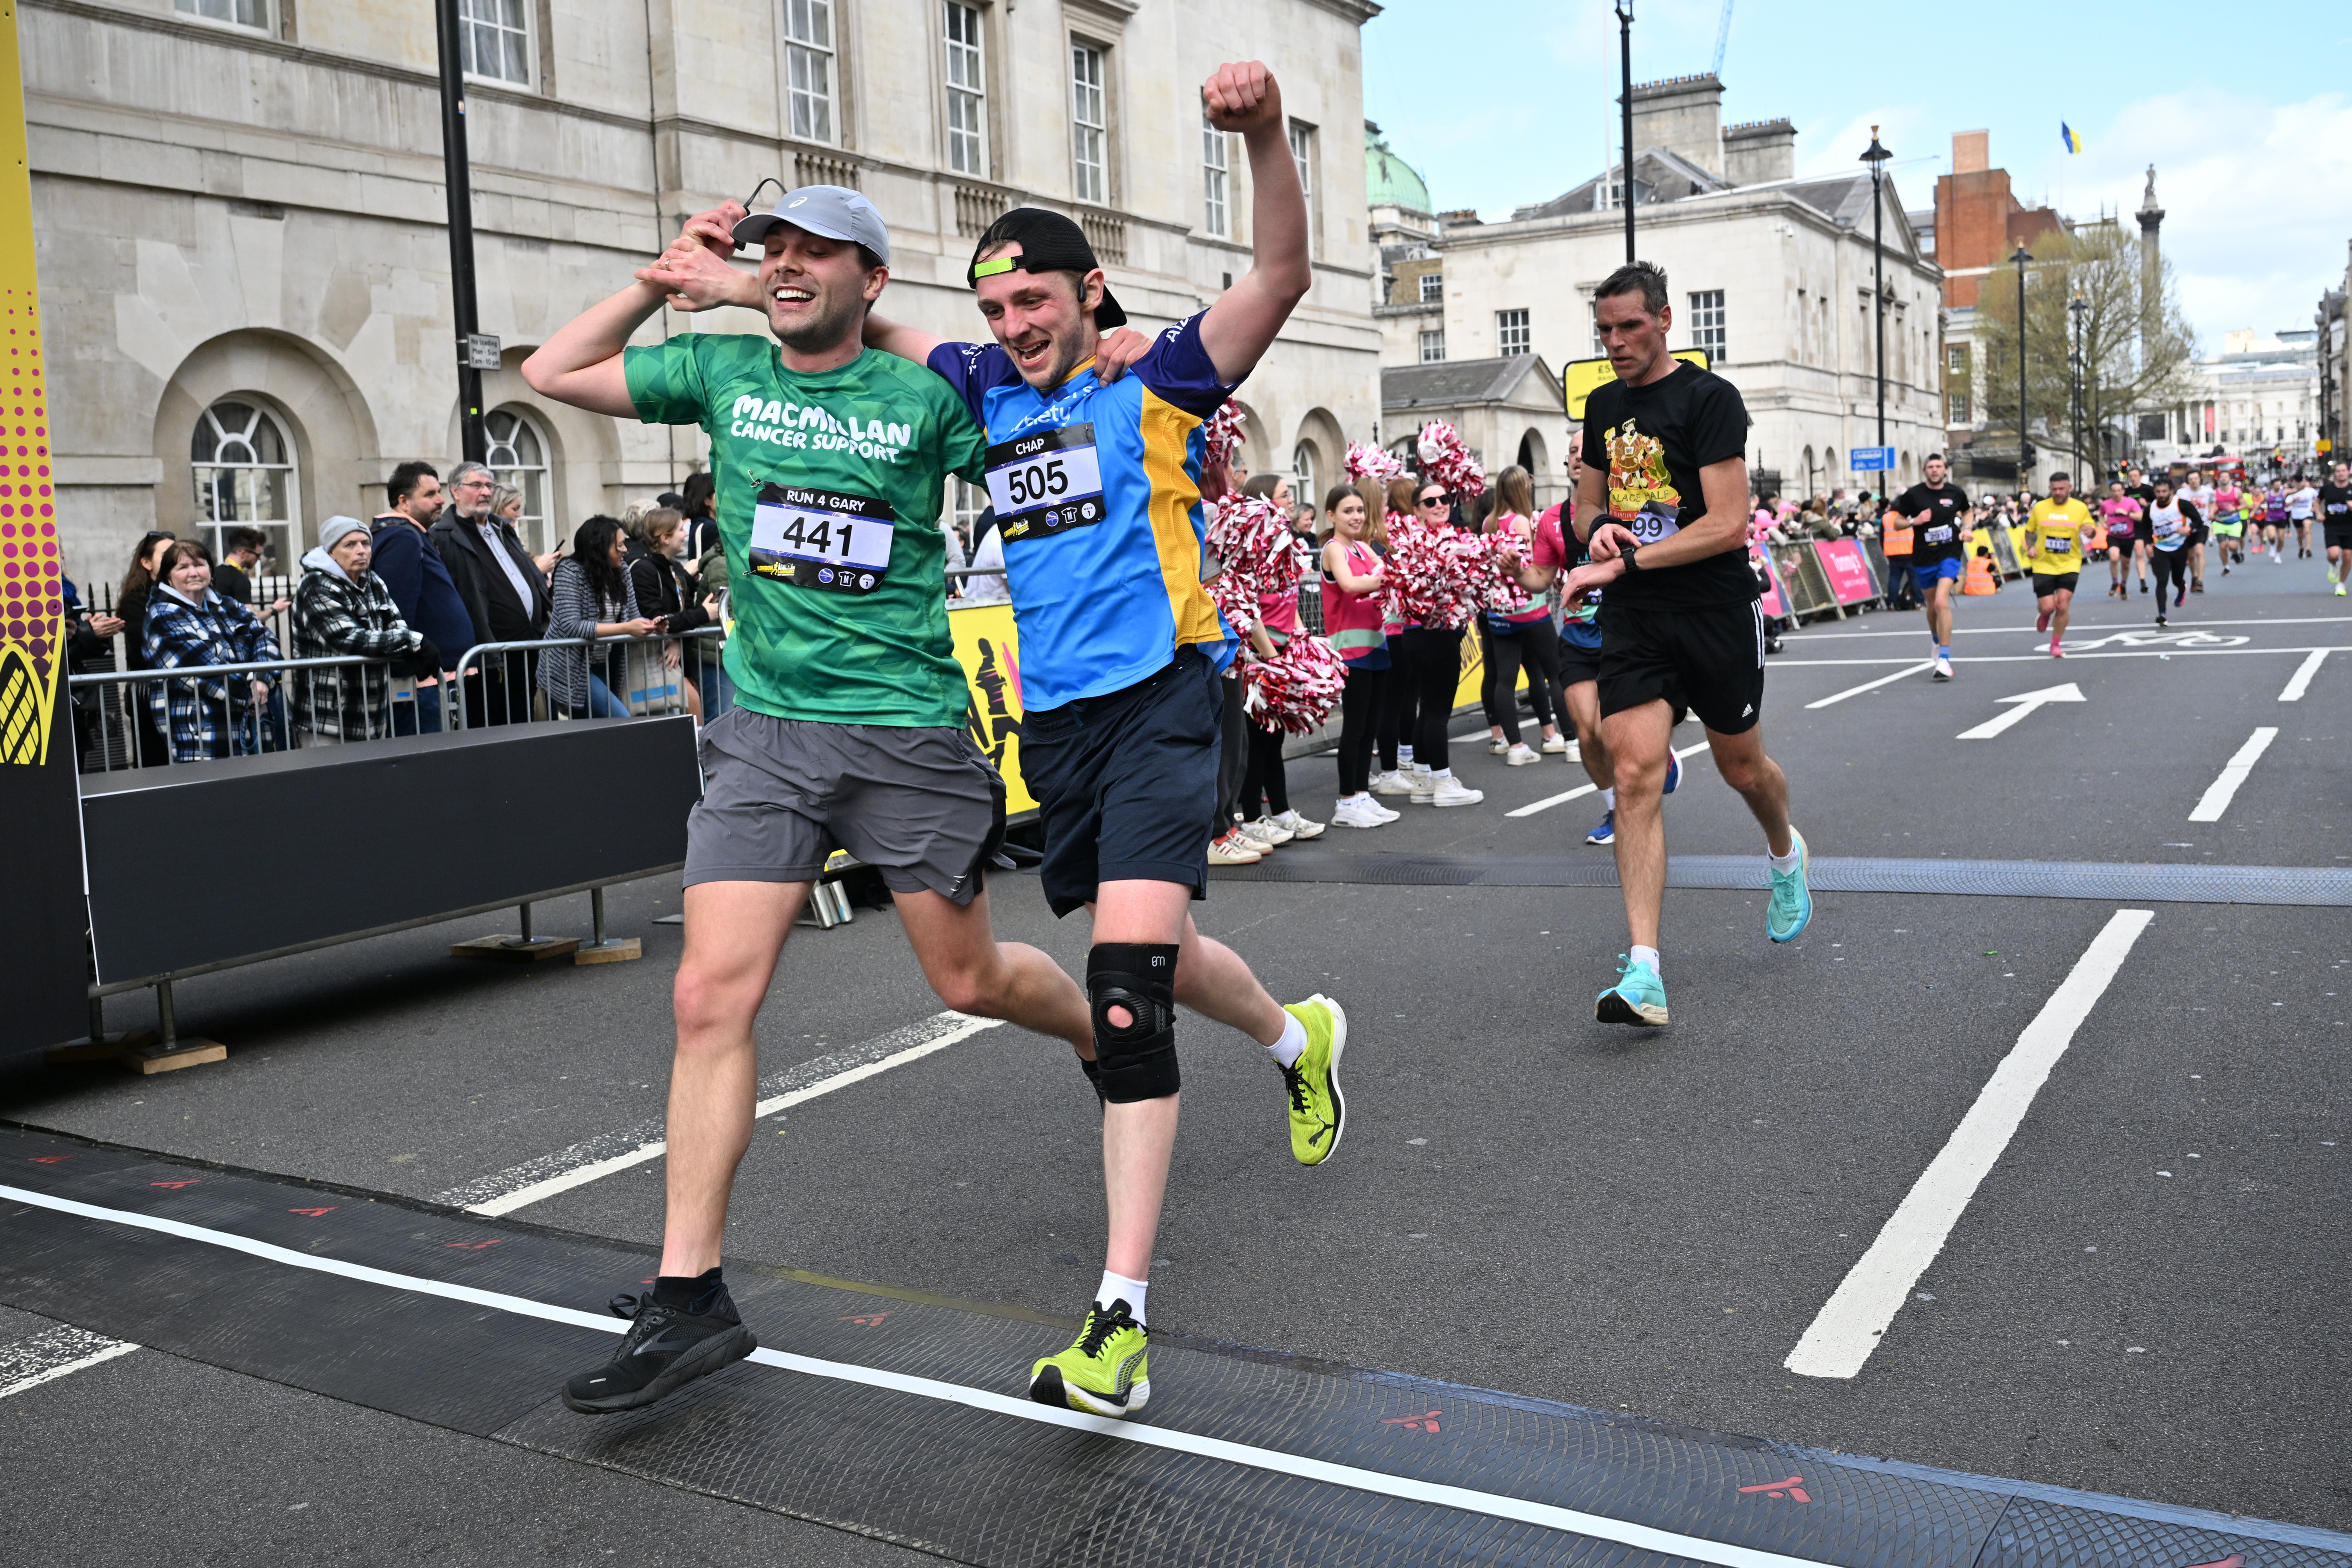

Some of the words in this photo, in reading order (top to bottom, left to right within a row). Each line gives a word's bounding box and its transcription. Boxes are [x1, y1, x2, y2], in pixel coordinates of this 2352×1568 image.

[479, 339, 497, 348] loading
[732, 394, 910, 446] MACMILLAN
[731, 420, 807, 449] CANCER
[811, 433, 900, 463] SUPPORT
[1016, 438, 1044, 455] CHAP
[1009, 459, 1068, 505] 505
[787, 490, 814, 504] RUN
[817, 495, 826, 506] 4
[830, 497, 866, 512] GARY
[1612, 493, 1640, 502] ALACE
[1644, 490, 1669, 500] HALF
[783, 517, 853, 557] 441
[638, 1339, 652, 1352] BROOKS
